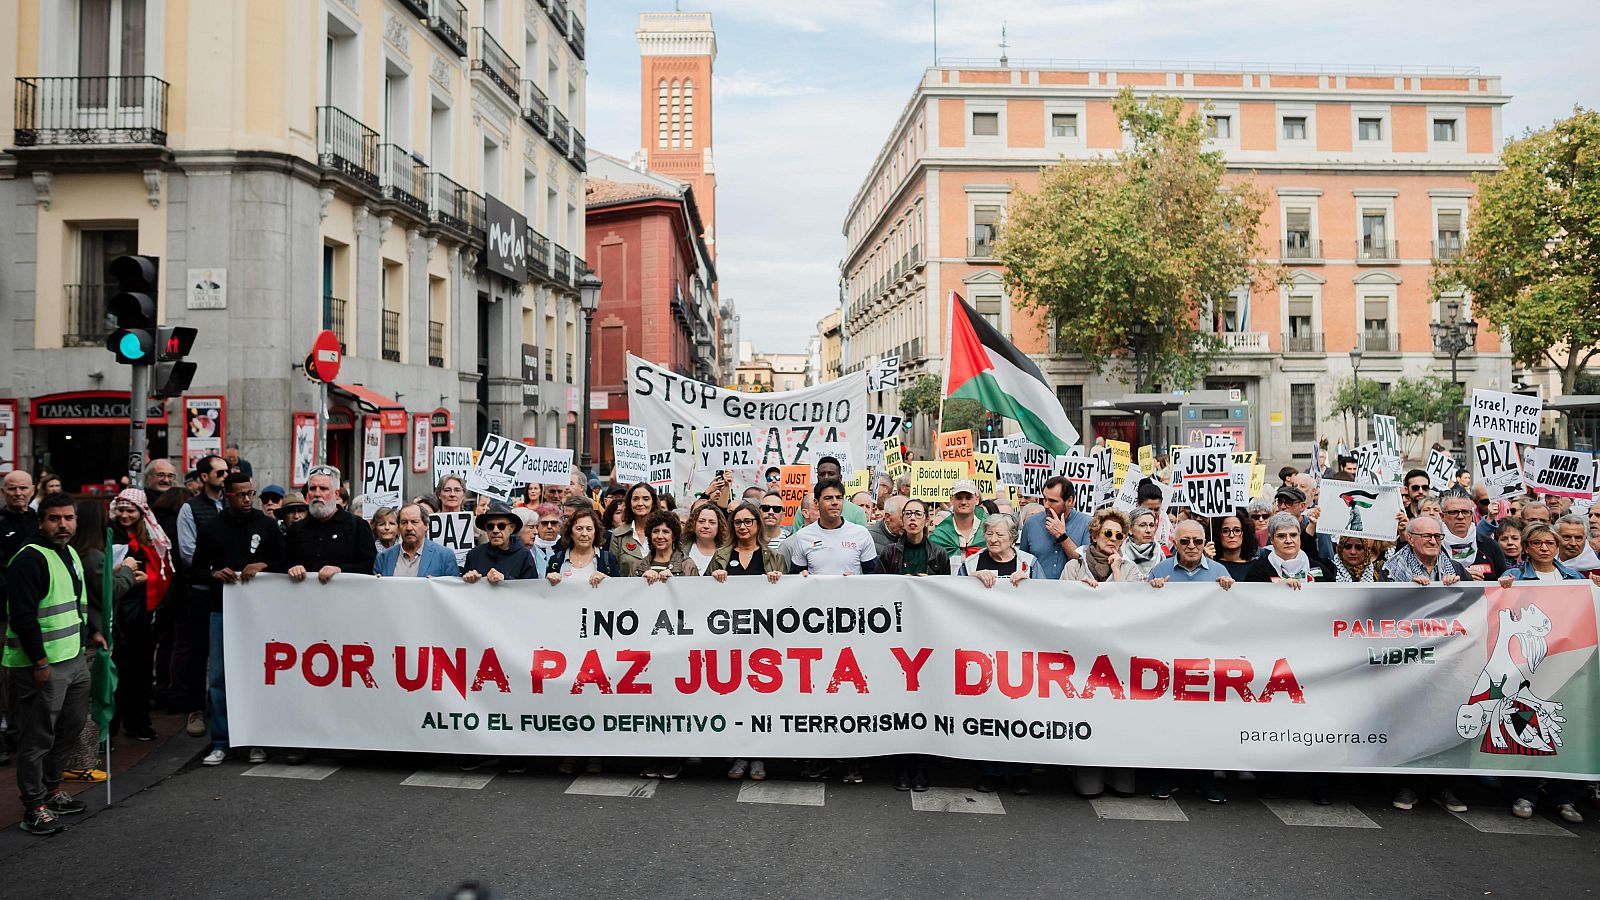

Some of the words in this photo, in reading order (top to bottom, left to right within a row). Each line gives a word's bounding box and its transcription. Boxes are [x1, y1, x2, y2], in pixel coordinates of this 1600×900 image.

[880, 357, 899, 390] PAZ
[636, 366, 718, 409] STOP
[41, 403, 82, 417] TAPAS
[1474, 395, 1510, 415] Israel,
[1515, 404, 1541, 417] peor
[614, 425, 645, 438] BOICOT
[867, 414, 902, 440] PAZ
[615, 437, 646, 450] ISRAEL:
[702, 431, 753, 448] JUSTICIA
[883, 437, 899, 451] PAZ
[945, 436, 967, 447] JUST
[1376, 417, 1400, 458] PAZ
[437, 450, 470, 466] JUSTICIA
[478, 433, 527, 477] PAZ
[616, 449, 626, 460] con
[650, 451, 672, 466] PAZ
[702, 451, 710, 467] Y
[723, 450, 754, 466] PAZ.
[886, 451, 900, 465] JUSTA
[942, 448, 973, 460] PEACE
[1024, 449, 1050, 465] JUST
[1185, 453, 1227, 475] JUST
[1476, 440, 1517, 477] PAZ
[522, 454, 542, 471] Pact
[543, 457, 571, 475] peace!
[916, 467, 942, 481] ¡Boicot
[943, 467, 960, 480] total
[1060, 461, 1094, 479] JUST
[1427, 452, 1456, 484] PAZ
[1549, 454, 1580, 475] WAR
[364, 458, 401, 495] PAZ
[650, 468, 672, 482] JUSTA
[785, 473, 807, 485] JUST
[1536, 468, 1591, 492] CRIMES!
[912, 485, 920, 497] al
[921, 485, 941, 497] Israel
[1187, 478, 1233, 514] PEACE
[430, 513, 472, 550] PAZ
[650, 609, 693, 636] AL
[706, 601, 902, 638] GENOCIDIO!
[1332, 618, 1467, 638] PALESTINA
[1367, 645, 1436, 665] LIBRE
[265, 638, 379, 689] POR
[393, 646, 511, 700] UNA
[531, 647, 653, 695] PAZ
[675, 646, 869, 695] JUSTA
[890, 647, 934, 692] Y
[955, 648, 1305, 704] DURADERA
[421, 712, 480, 731] ALTO
[487, 713, 514, 732] EL
[520, 714, 596, 733] FUEGO
[602, 714, 727, 735] DEFINITIVO
[751, 714, 772, 734] NI
[779, 711, 928, 734] TERRORISMO
[933, 714, 955, 737] NI
[963, 717, 1092, 741] GENOCIDIO
[1240, 725, 1388, 747] pararlaguerra.es
